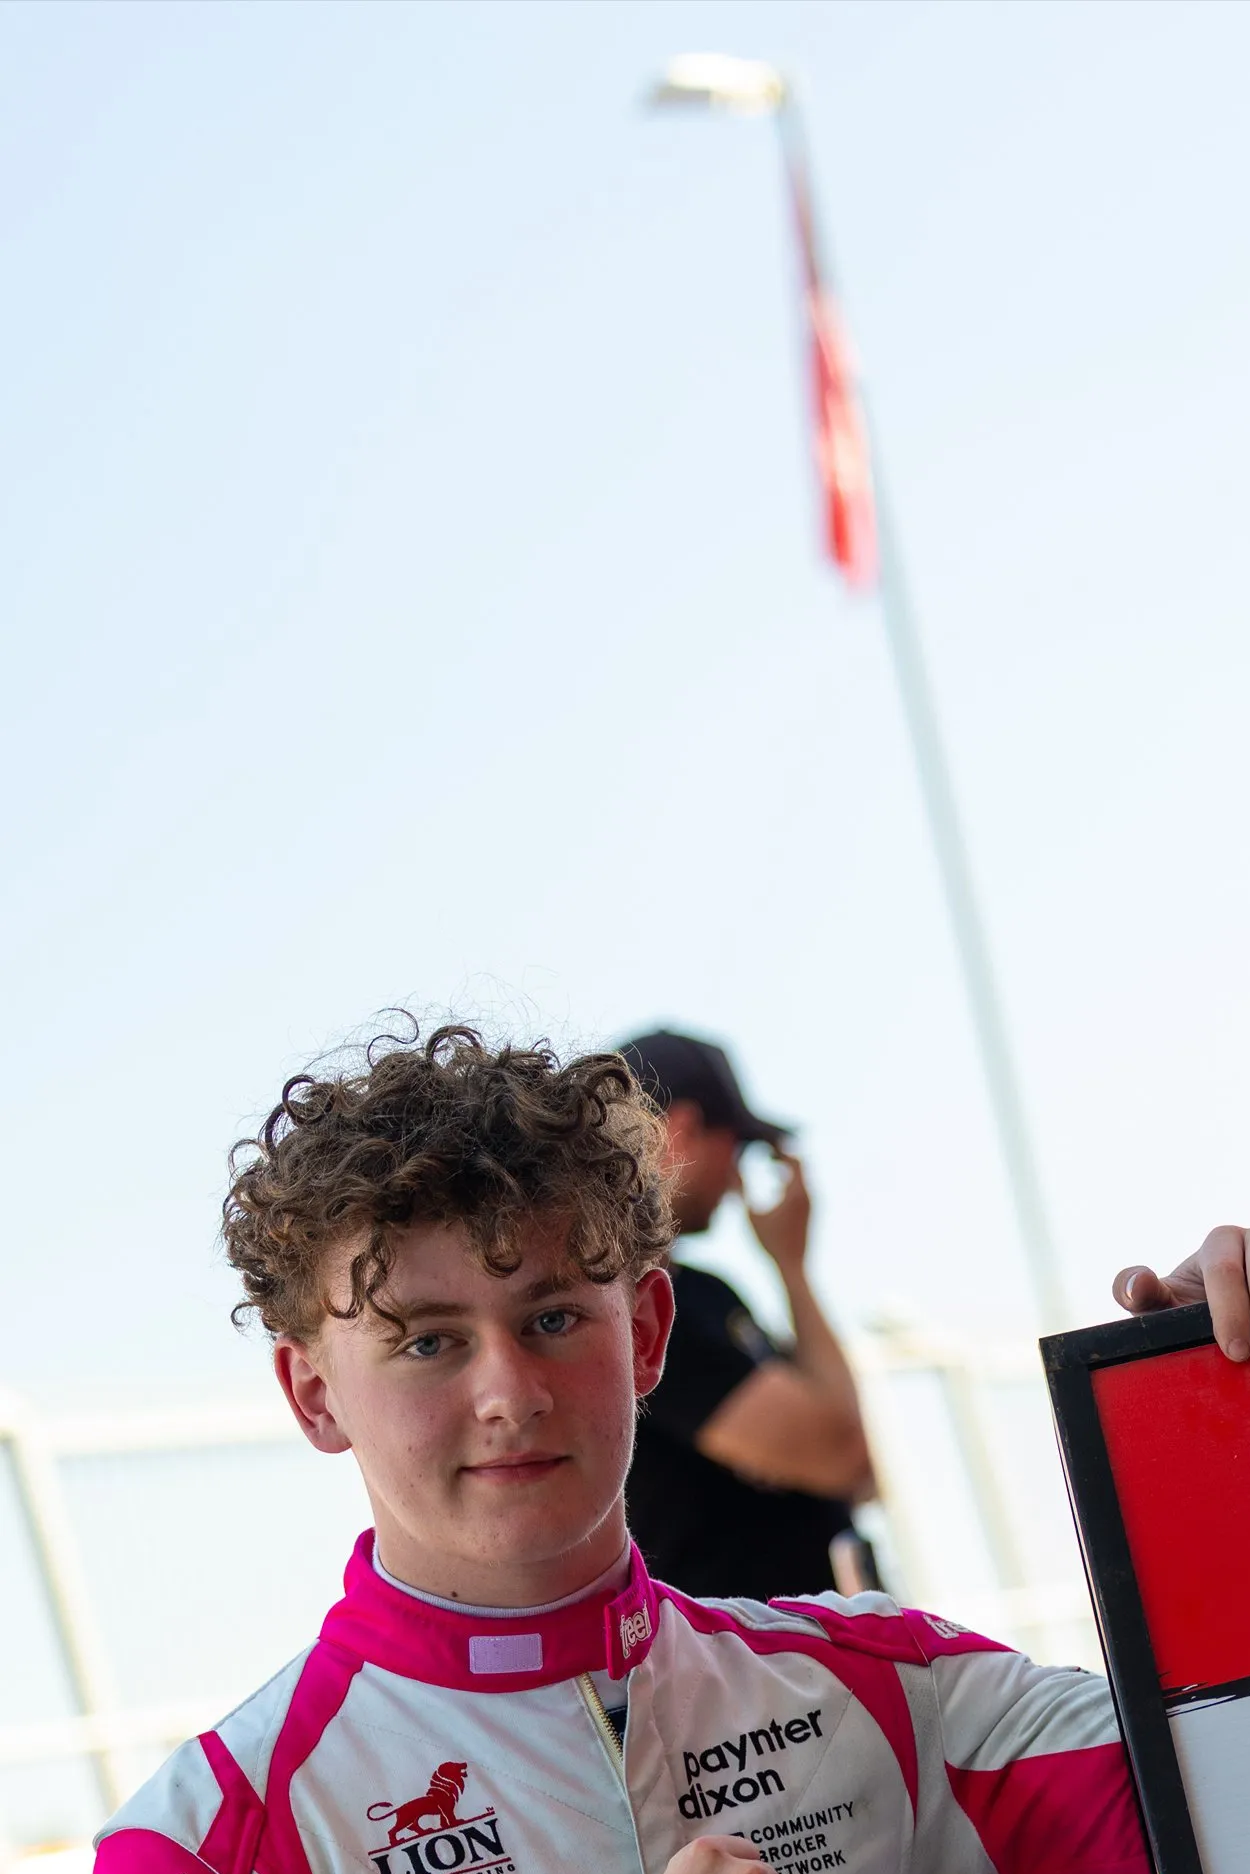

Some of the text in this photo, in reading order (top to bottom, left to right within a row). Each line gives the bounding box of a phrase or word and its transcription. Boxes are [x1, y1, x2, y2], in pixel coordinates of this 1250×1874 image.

[683, 1709, 823, 1786] paynter
[677, 1769, 785, 1819] dixon
[751, 1801, 854, 1844] COMMUNITY
[760, 1833, 827, 1863] BROKER
